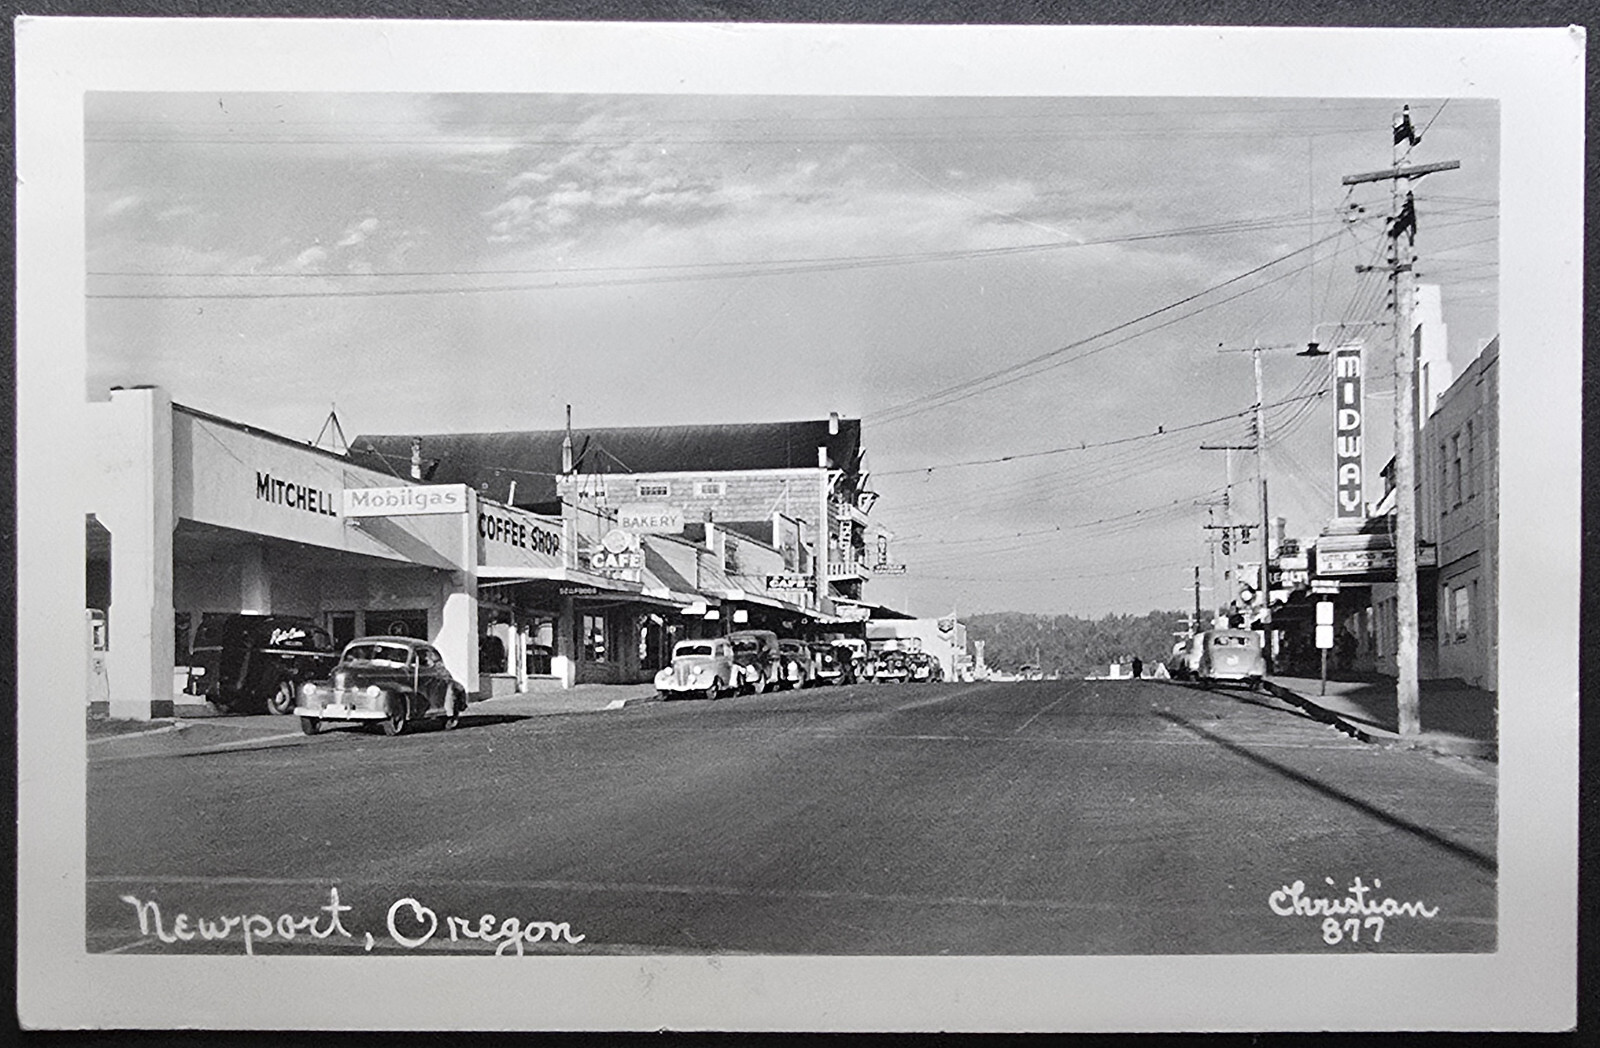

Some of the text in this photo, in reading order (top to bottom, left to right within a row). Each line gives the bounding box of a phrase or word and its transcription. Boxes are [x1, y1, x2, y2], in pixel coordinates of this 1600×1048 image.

[1336, 355, 1361, 512] MIDWAY
[256, 471, 338, 518] MITCHELL
[350, 488, 458, 511] Mobilgas
[622, 515, 679, 529] BAKERY
[478, 513, 560, 557] COFFEE SHOP
[591, 553, 641, 568] CAFE
[769, 579, 806, 589] CAFE
